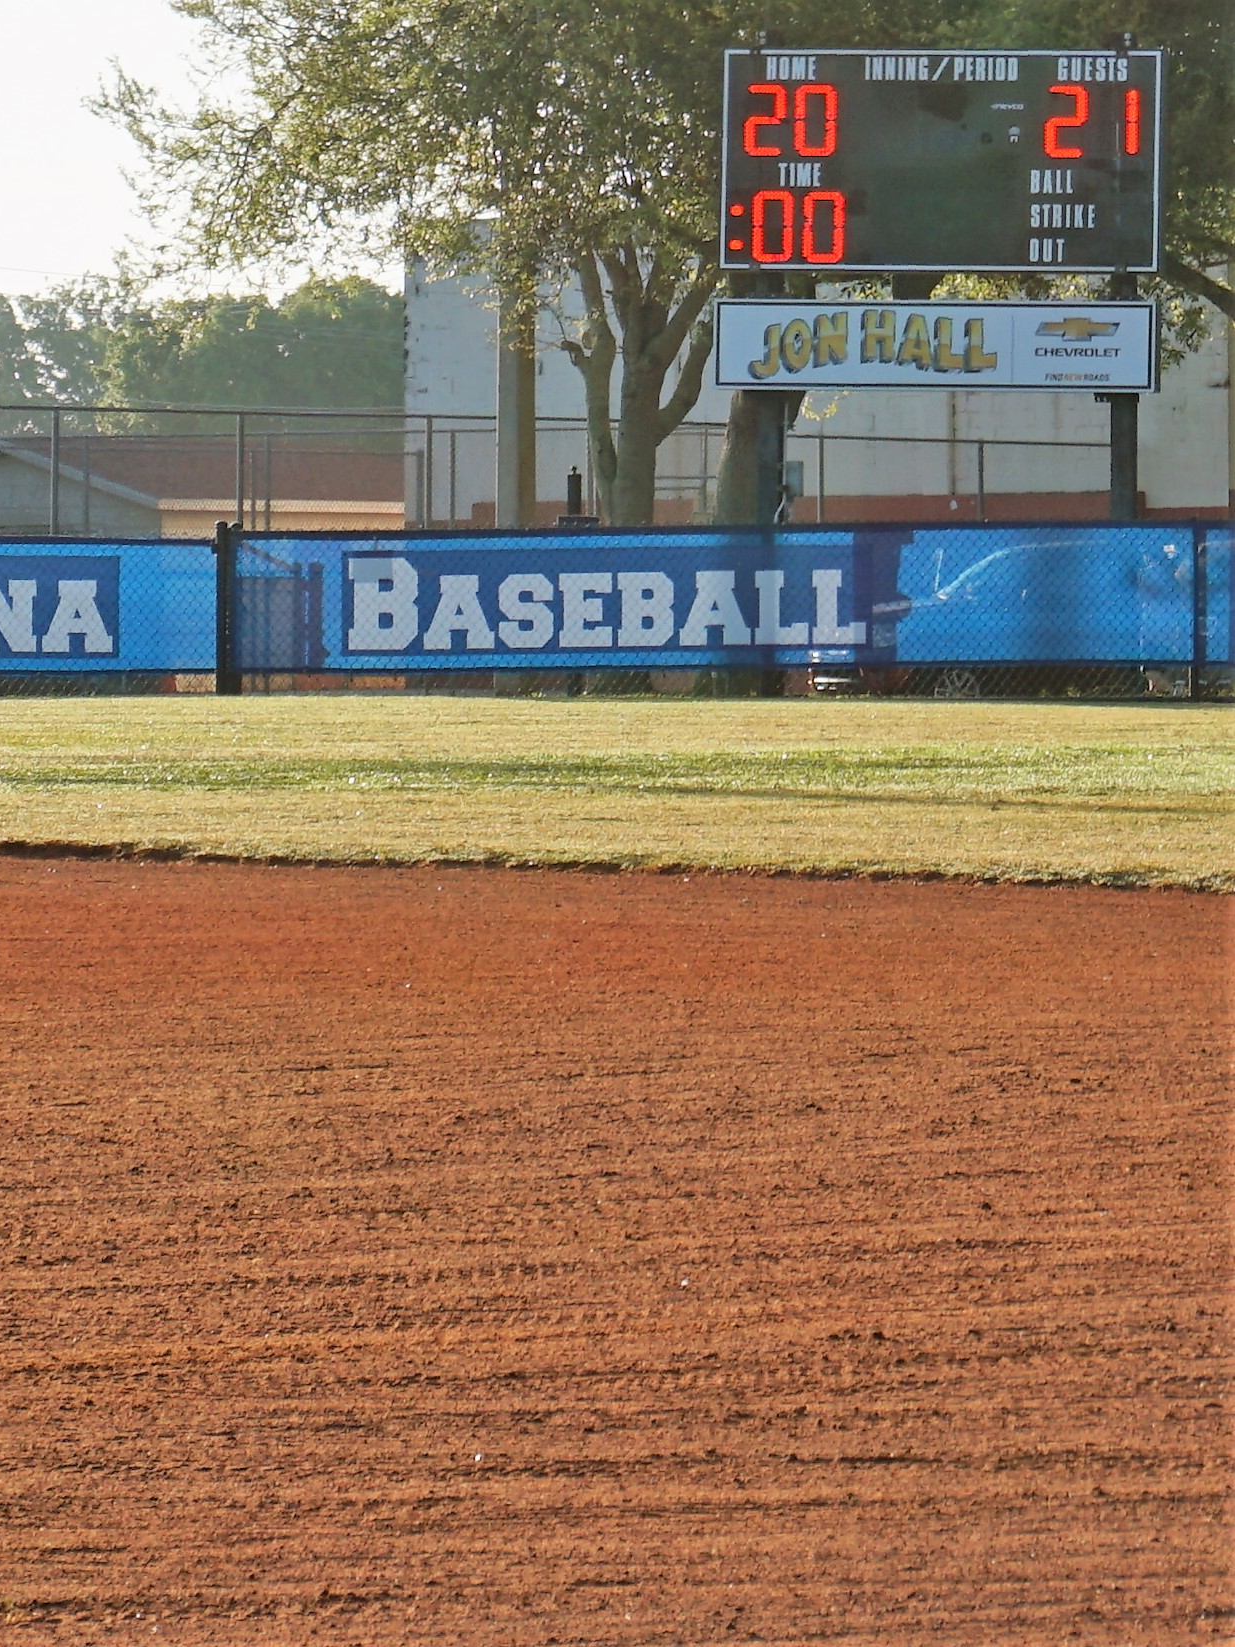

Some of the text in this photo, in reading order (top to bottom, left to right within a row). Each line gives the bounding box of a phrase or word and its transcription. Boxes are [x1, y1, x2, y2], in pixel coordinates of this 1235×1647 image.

[766, 56, 817, 81] HOME
[1057, 57, 1129, 82] GUESTS
[742, 83, 839, 157] 20
[1043, 85, 1141, 159] 21
[778, 163, 822, 187] TIME
[1030, 170, 1074, 194] BALL
[1030, 204, 1096, 229] STRIKE
[1030, 238, 1065, 263] OUT
[748, 308, 998, 380] JON HALL
[1034, 347, 1121, 358] CHEVROLET
[347, 556, 868, 652] BASEBALL
